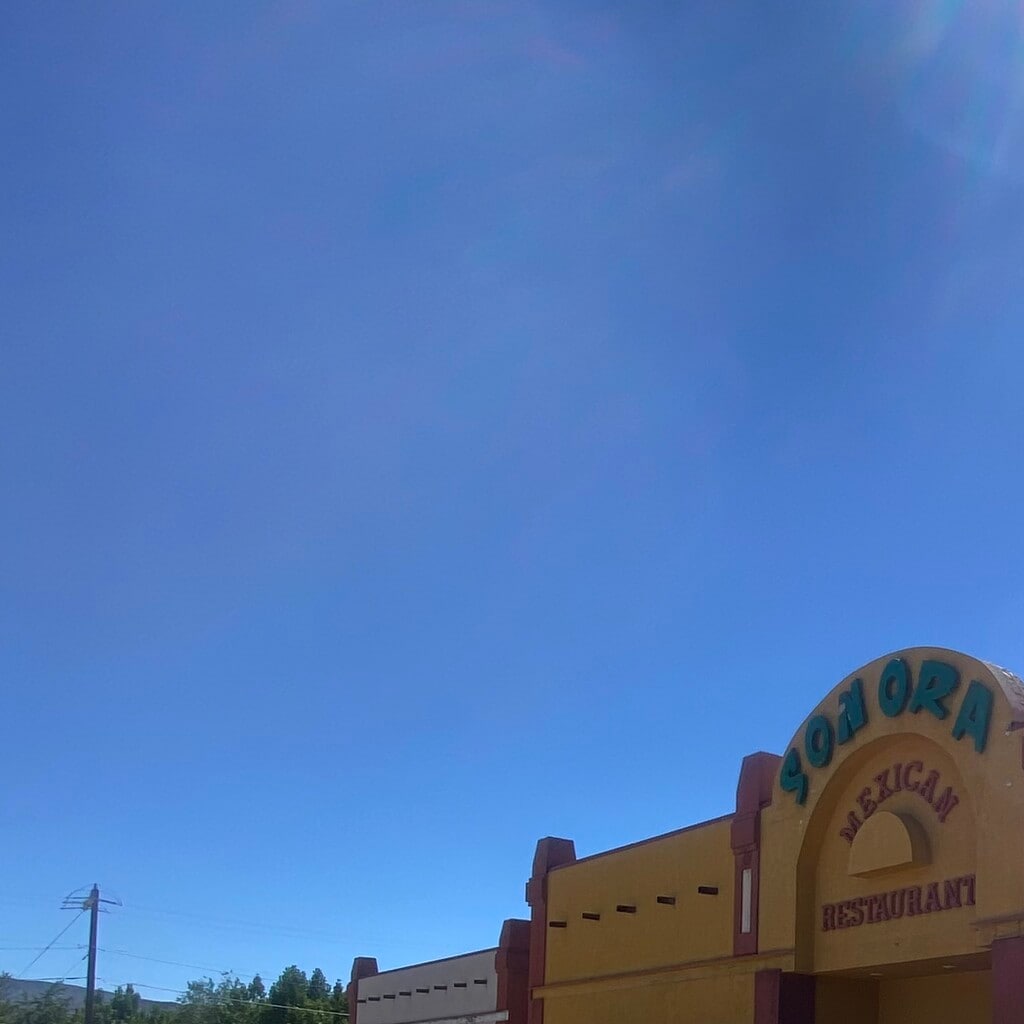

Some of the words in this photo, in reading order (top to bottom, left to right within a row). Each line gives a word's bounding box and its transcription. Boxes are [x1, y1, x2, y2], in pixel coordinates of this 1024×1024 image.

[779, 658, 993, 805] SONORA
[840, 761, 960, 842] MEXICAN
[821, 874, 976, 931] RESTAURANT
